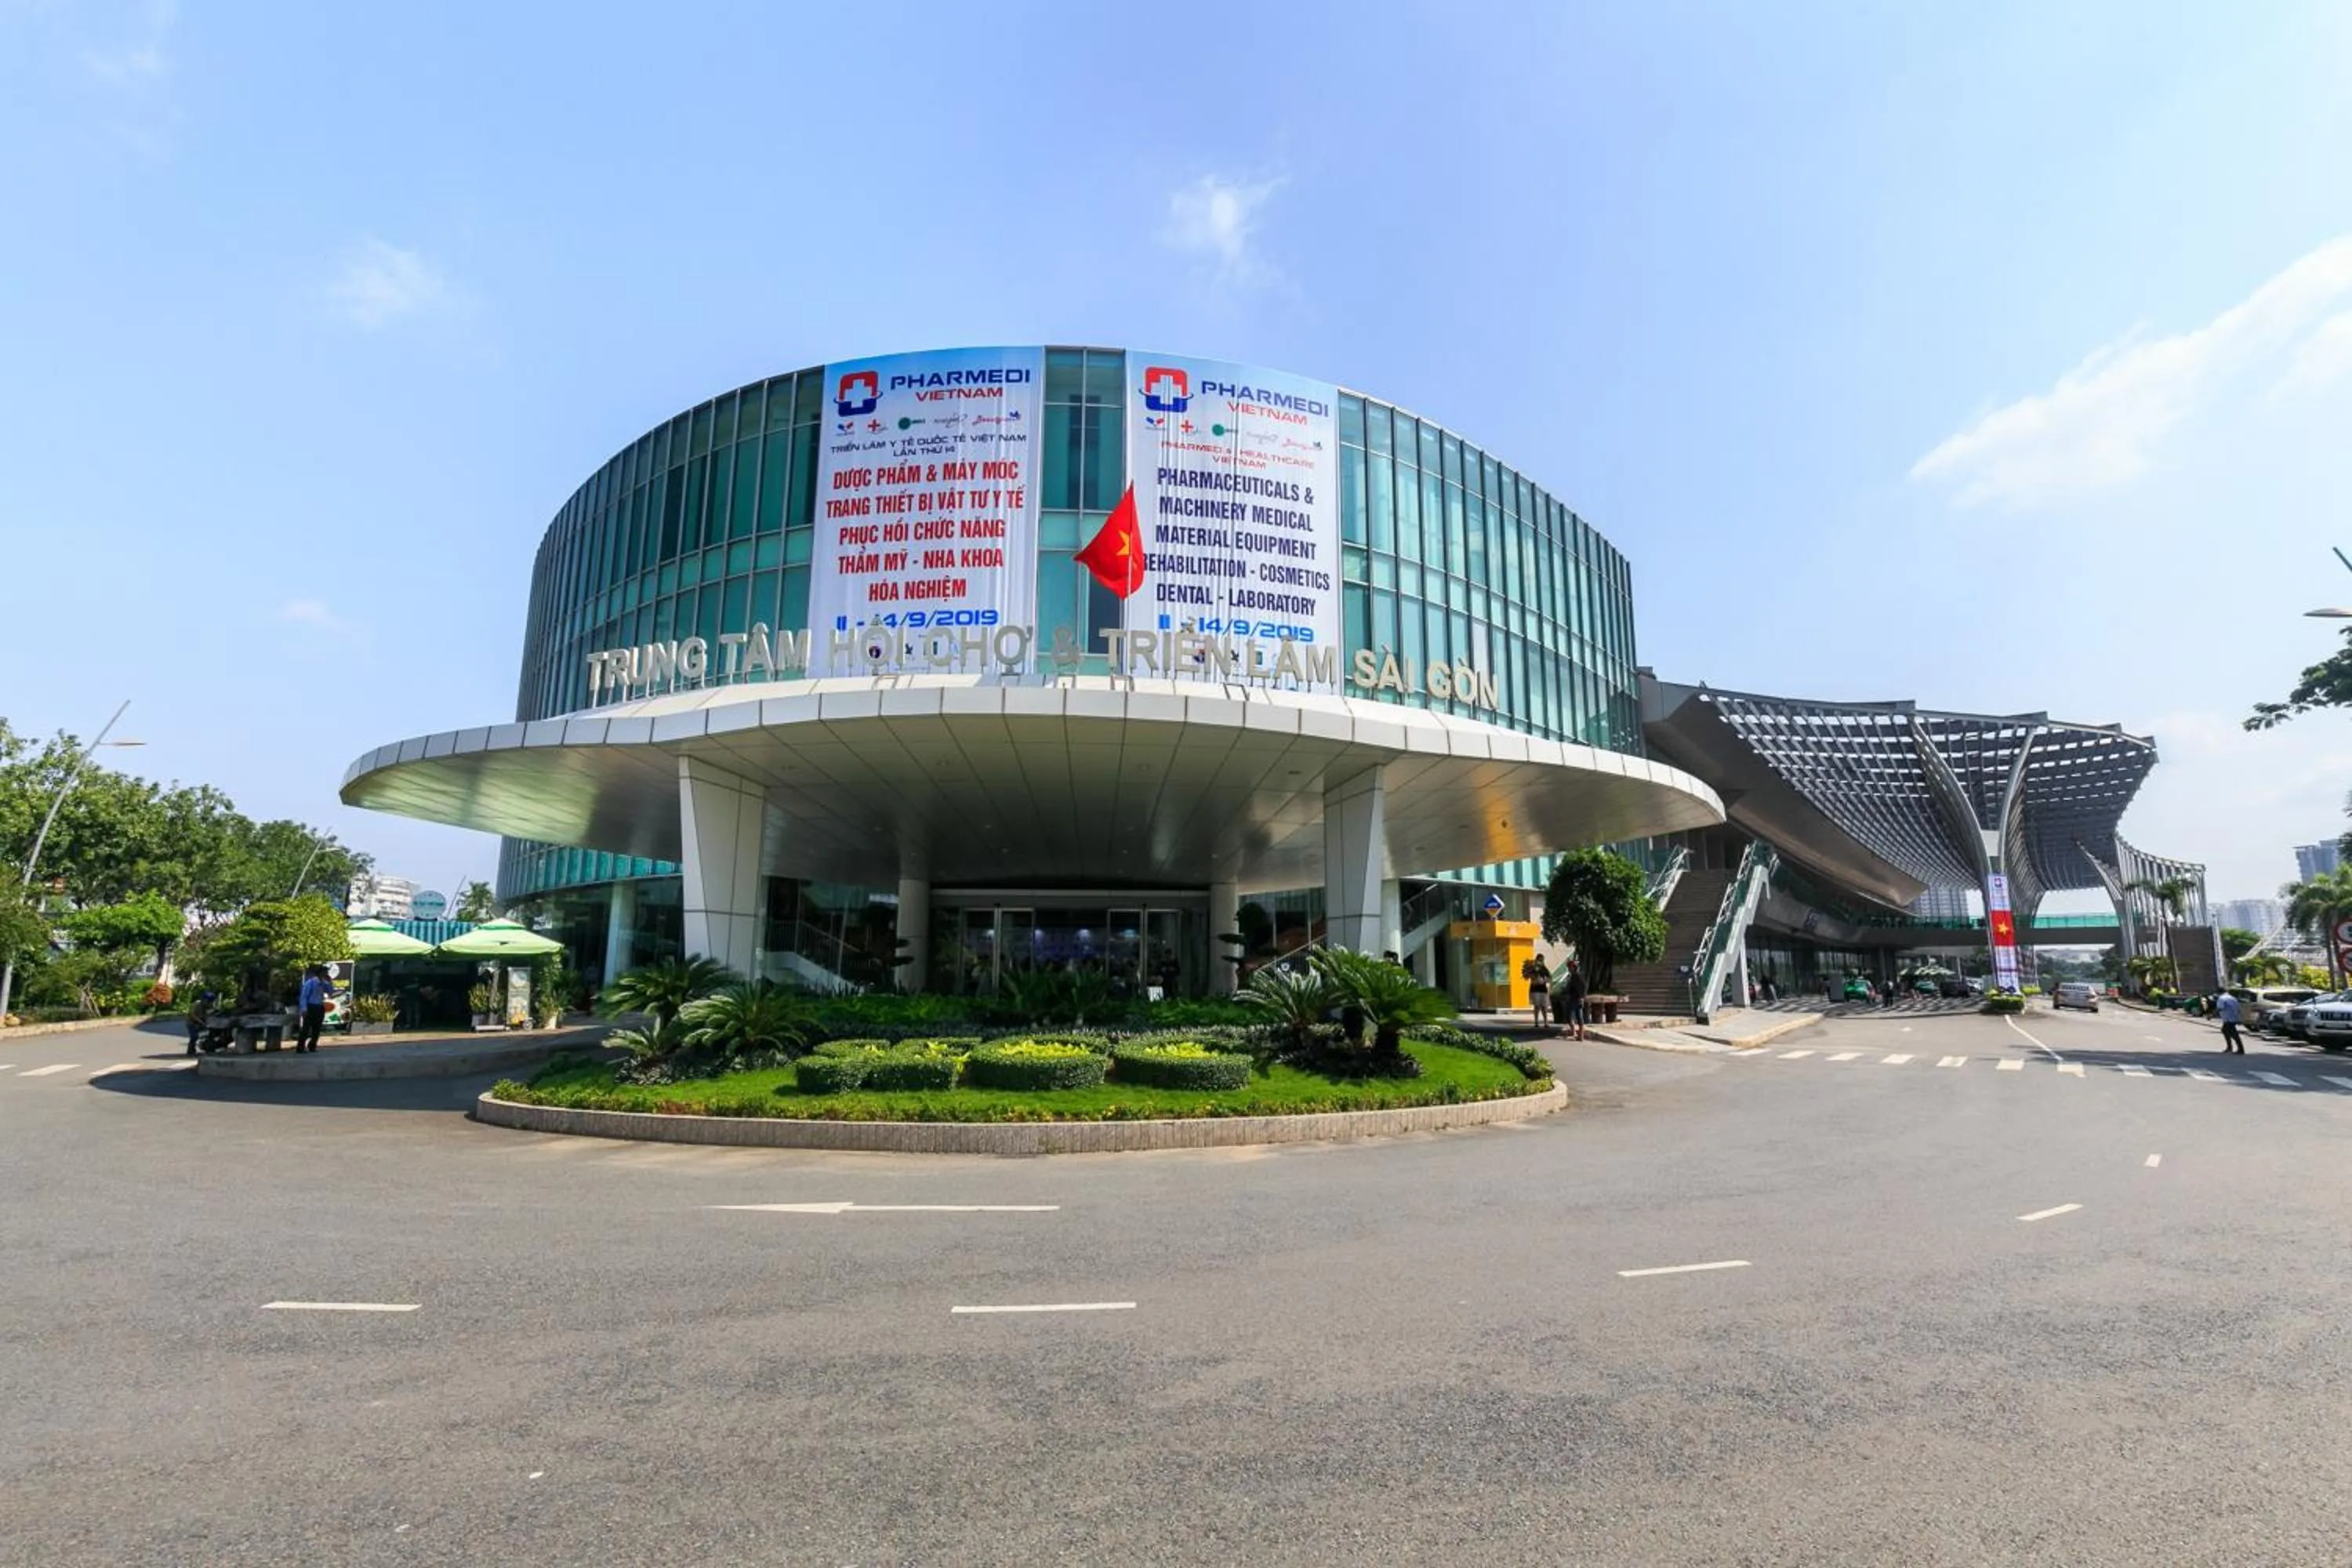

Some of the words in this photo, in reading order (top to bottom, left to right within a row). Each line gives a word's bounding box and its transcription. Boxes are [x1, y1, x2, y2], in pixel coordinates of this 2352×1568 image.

[890, 368, 1030, 390] PHARMEDI
[915, 387, 1004, 402] VIETNAM
[1201, 380, 1329, 418] PHARMEDI
[1227, 401, 1308, 426] VIETNAM
[998, 434, 1026, 443] NAM
[1212, 455, 1266, 470] VIETNAM
[1240, 450, 1315, 469] HEALTHCARE
[833, 468, 873, 492] DƯỢC
[877, 459, 921, 485] PHẨM
[926, 464, 938, 482] &
[942, 458, 978, 481] MÁY
[982, 459, 1019, 480] MÓC
[1157, 467, 1299, 503] PHARMACEUTICALS
[1304, 487, 1314, 505] &
[826, 499, 870, 518] TRANG
[876, 488, 915, 514] THIẾT
[919, 492, 933, 515] BỊ
[938, 488, 965, 514] VẬT
[969, 490, 989, 510] TƯ
[993, 490, 1002, 509] Y
[1007, 485, 1025, 509] TẾ
[1159, 496, 1247, 521] MACHINERY
[1252, 506, 1313, 532] MEDICAL
[839, 524, 879, 546] PHỤC
[913, 517, 956, 541] CHỨC
[960, 516, 1006, 538] NĂNG
[1156, 524, 1230, 549] MATERIAL
[1235, 531, 1316, 561] EQUIPMENT
[838, 546, 879, 575] THẨM
[884, 548, 909, 572] MỸ
[923, 550, 956, 569] NHA
[960, 548, 1004, 568] KHOA
[1142, 553, 1247, 579] REHABILITATION
[1259, 563, 1330, 591] COSMETICS
[869, 578, 899, 602] HÓA
[904, 575, 967, 602] NGHIỆM
[1156, 583, 1214, 606] DENTAL
[1229, 588, 1316, 616] LABORATORY
[875, 609, 1000, 628] 4/9/2019
[1199, 617, 1315, 643] 14/9/2019
[587, 636, 708, 691] TRUNG
[720, 622, 811, 674] TÂM
[923, 625, 1033, 673] CHỢ
[1051, 627, 1083, 666] &
[1353, 643, 1415, 693] SÀI
[1427, 657, 1500, 710] GÒN
